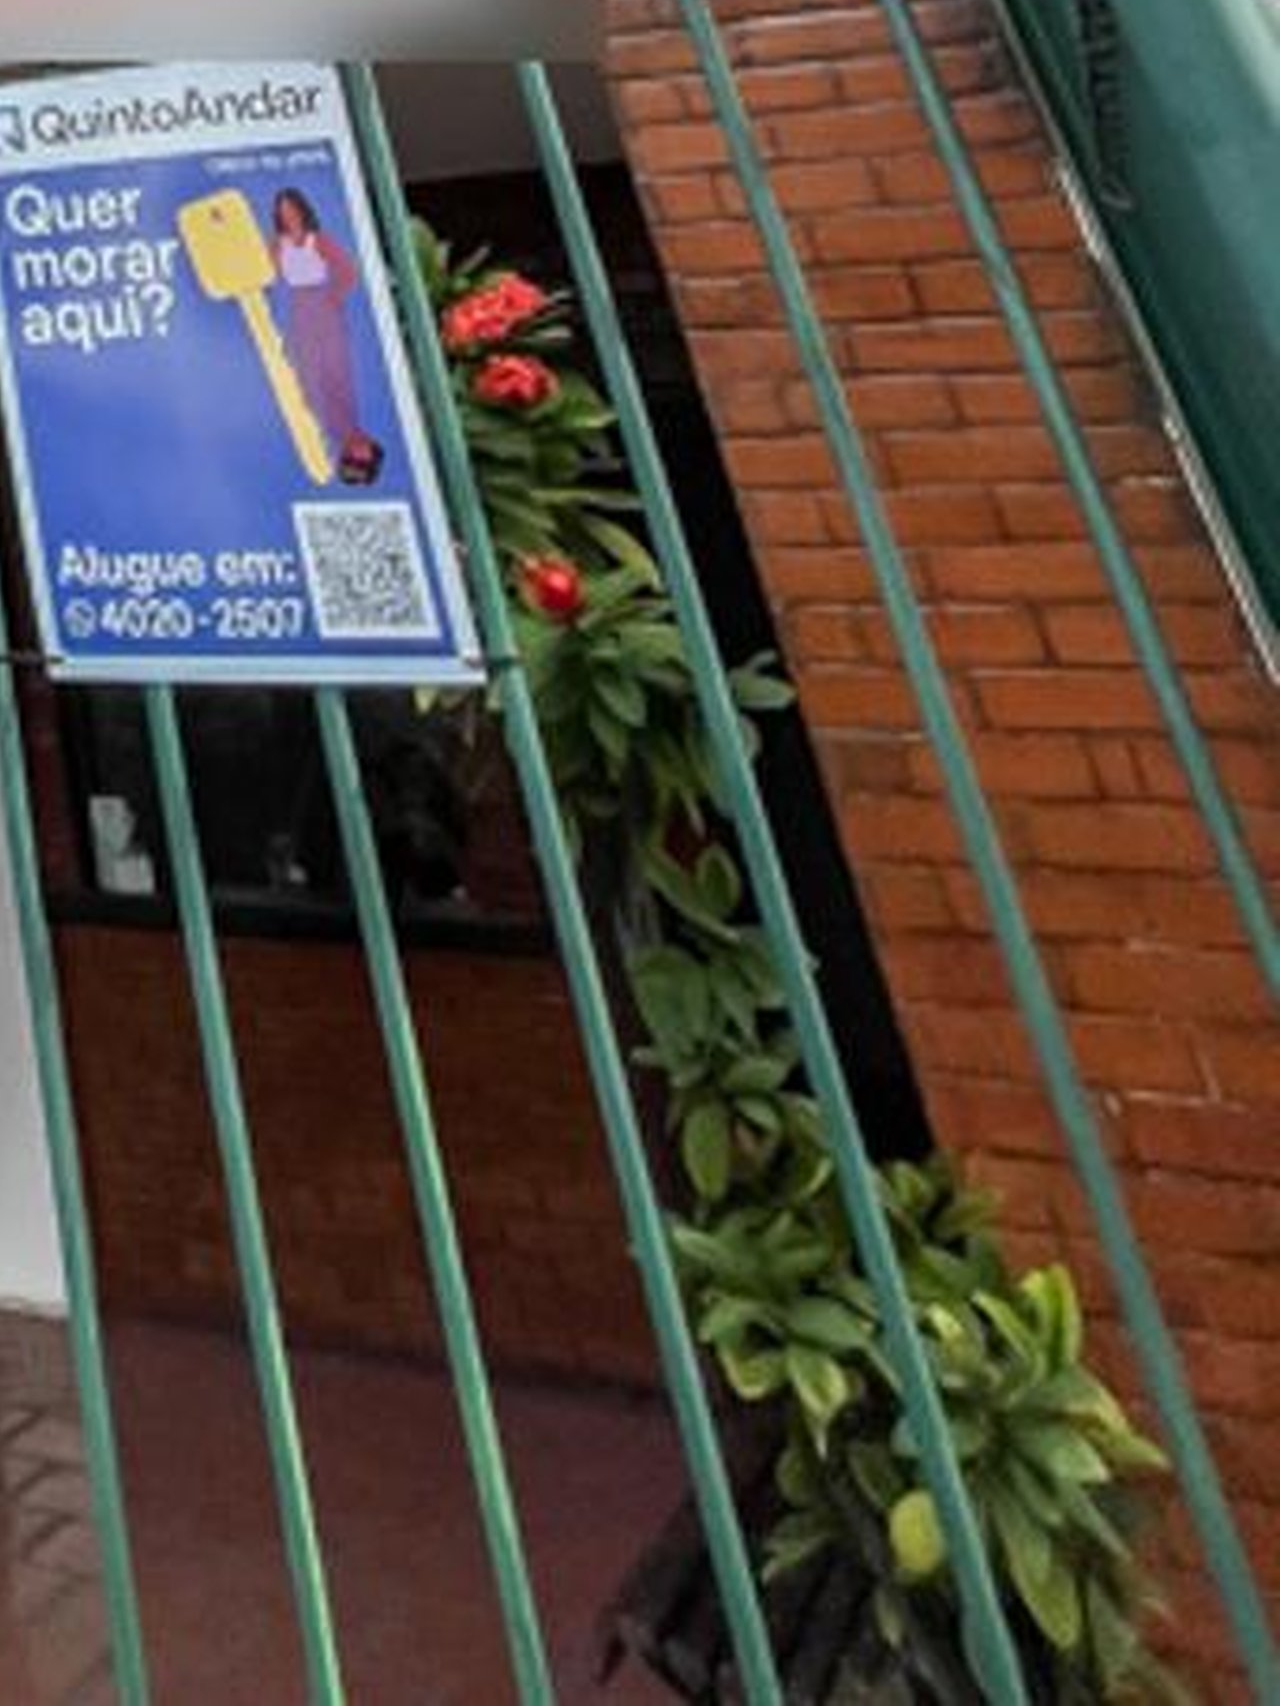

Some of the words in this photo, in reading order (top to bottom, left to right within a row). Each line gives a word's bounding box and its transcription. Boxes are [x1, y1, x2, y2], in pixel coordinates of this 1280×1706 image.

[31, 81, 321, 144] QuintoAndar
[6, 184, 141, 235] Quer
[15, 239, 180, 289] morar
[21, 284, 175, 353] aqui?
[58, 545, 205, 597] Alugue
[216, 551, 297, 586] em:
